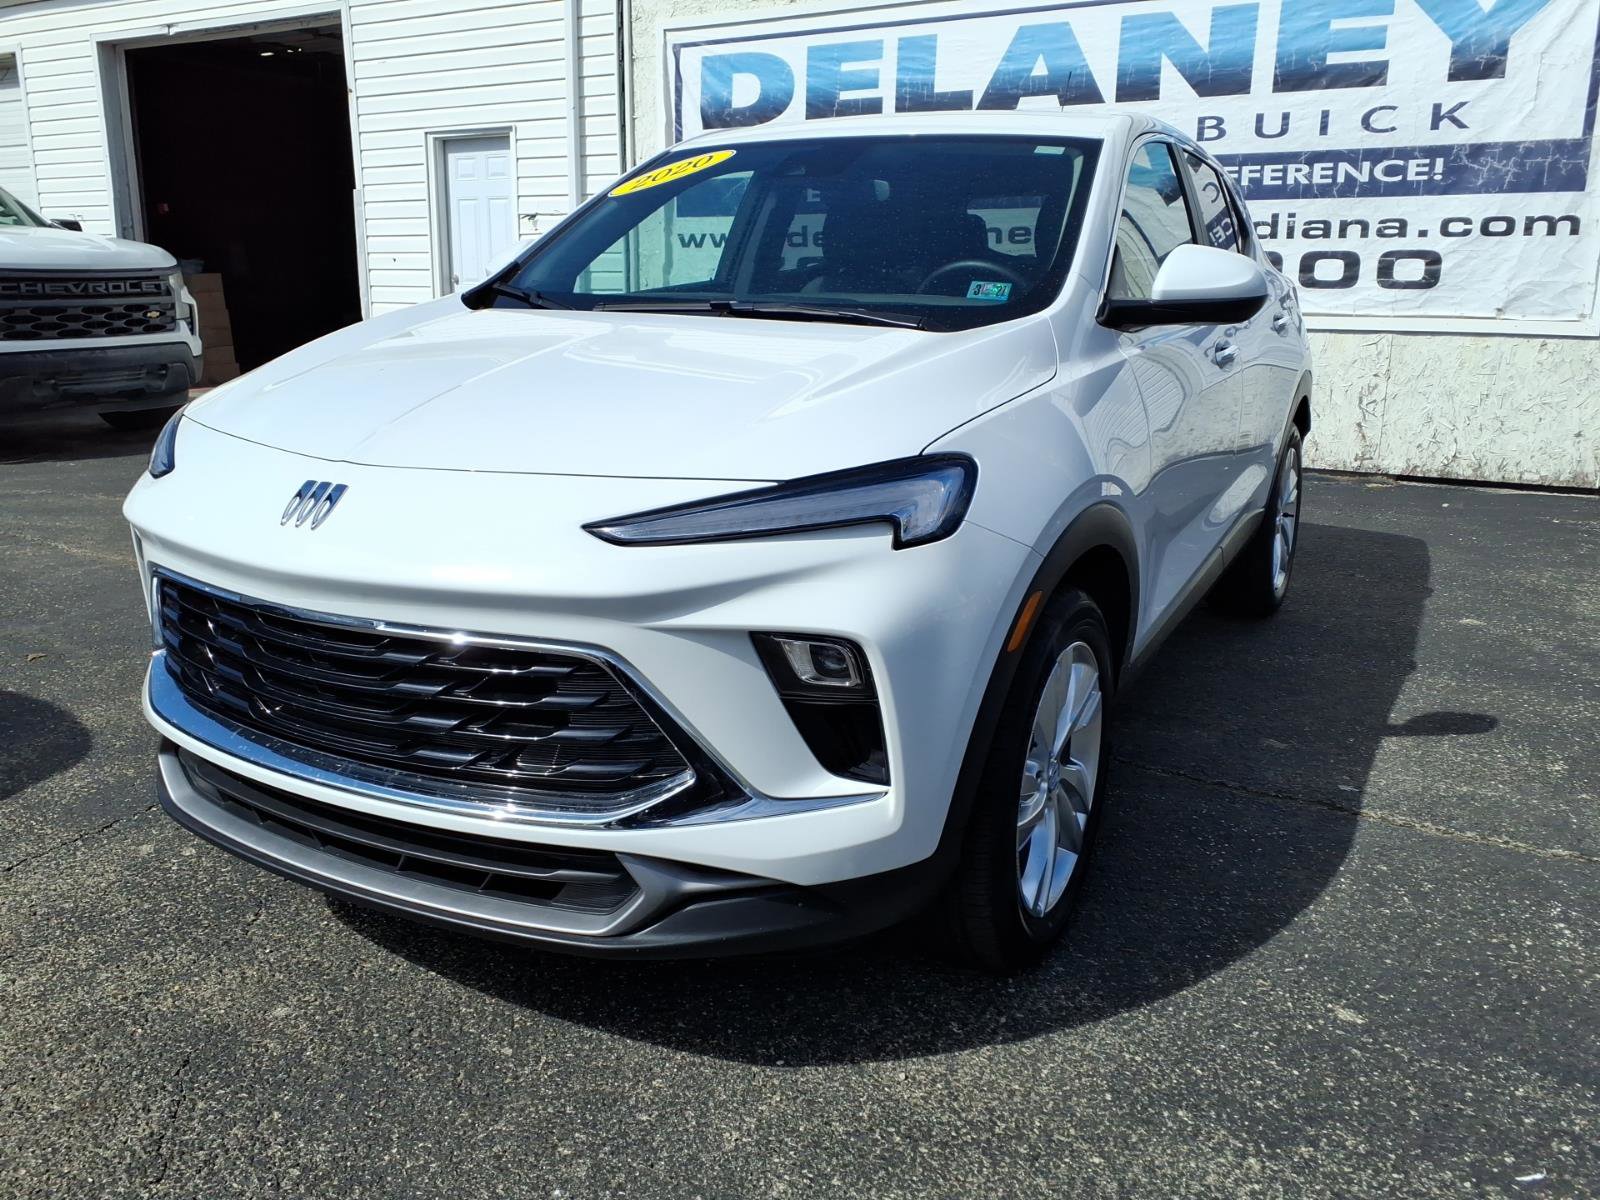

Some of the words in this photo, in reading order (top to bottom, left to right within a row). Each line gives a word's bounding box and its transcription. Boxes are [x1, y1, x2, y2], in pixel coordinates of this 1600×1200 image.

[700, 0, 1552, 130] DELANEY
[1196, 101, 1471, 142] BUICK
[631, 155, 713, 190] 2020
